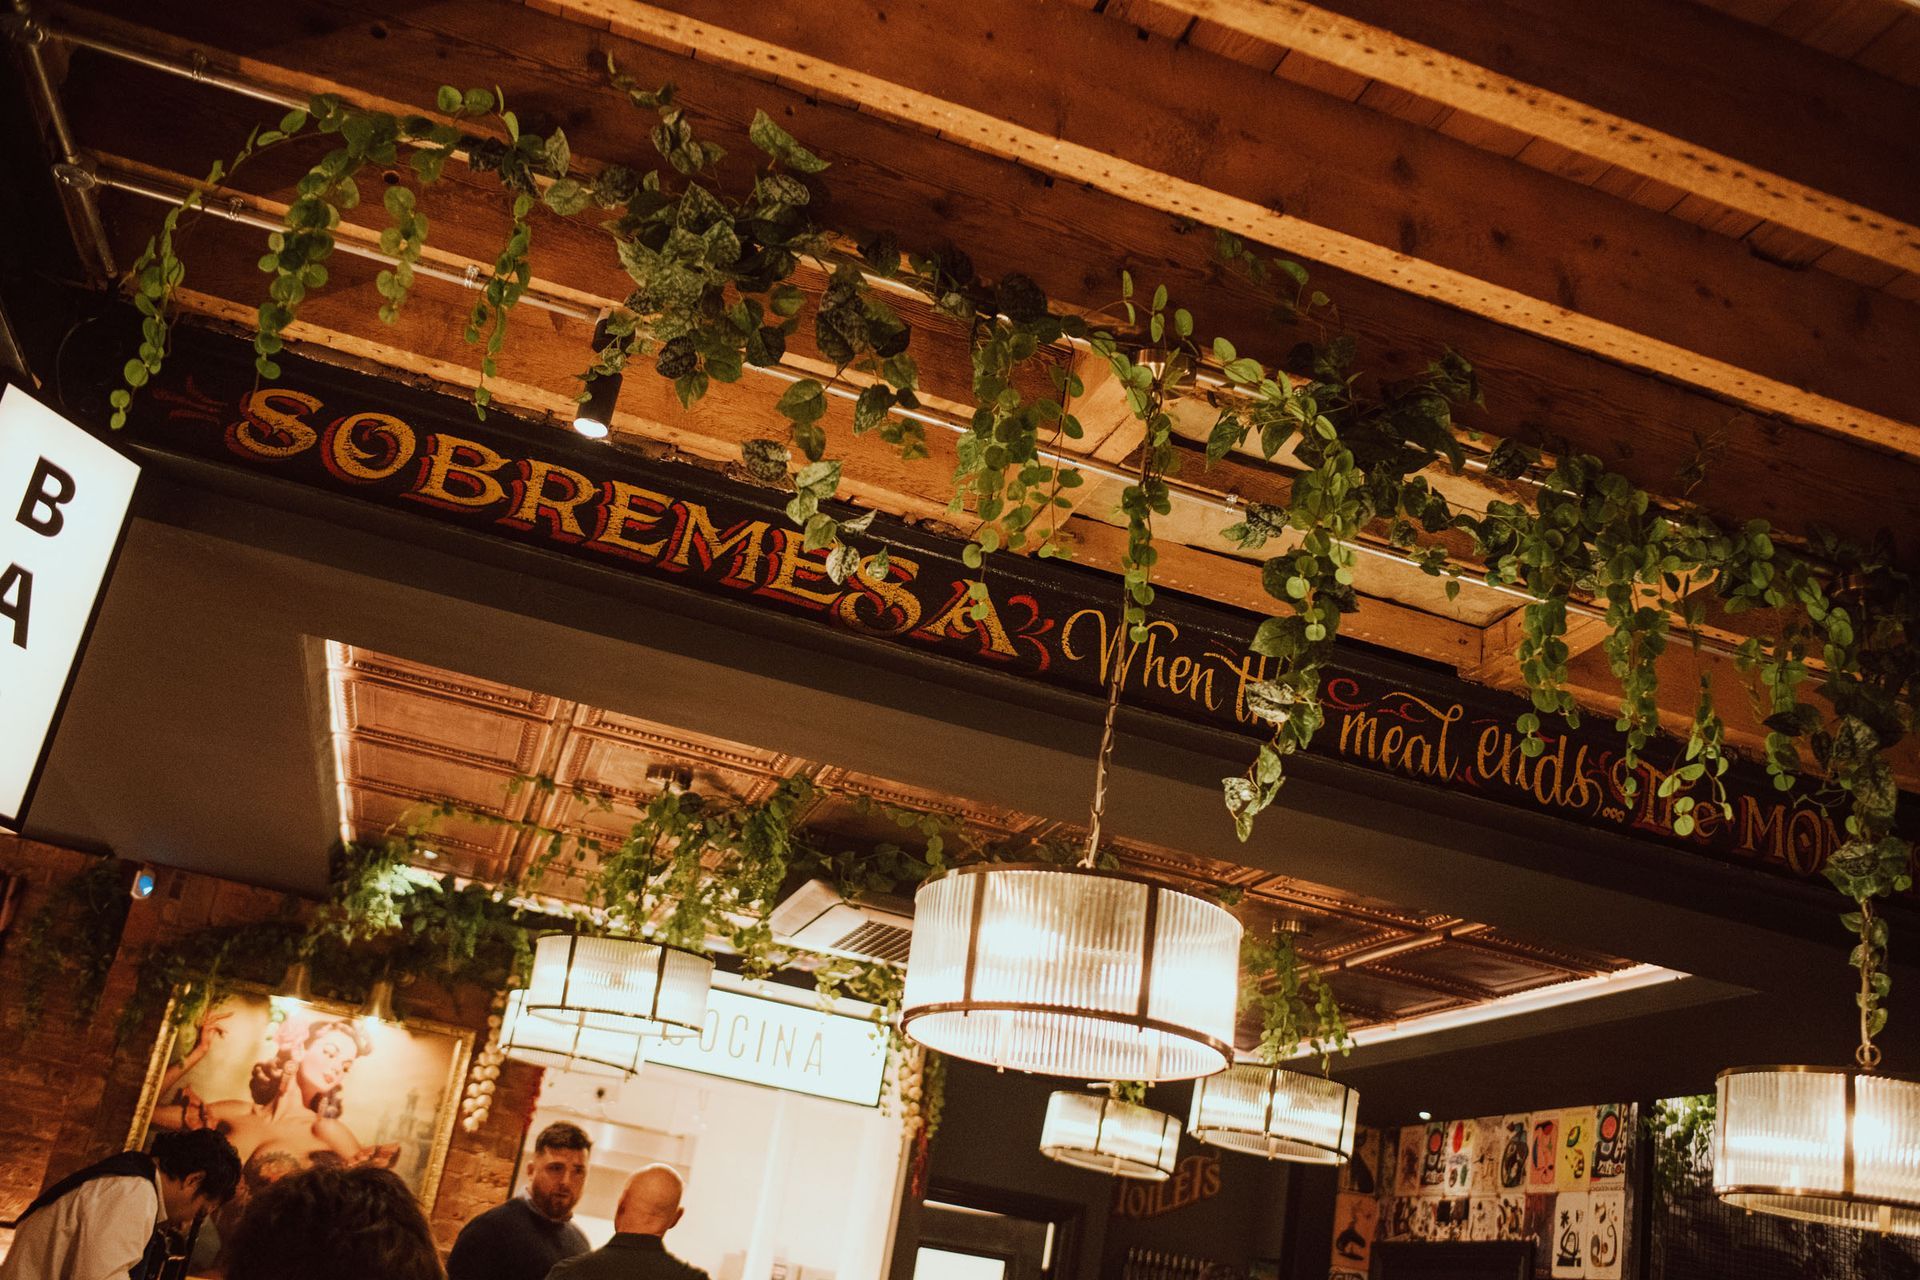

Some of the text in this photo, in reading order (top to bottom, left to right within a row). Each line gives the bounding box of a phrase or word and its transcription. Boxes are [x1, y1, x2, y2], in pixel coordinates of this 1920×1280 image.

[226, 388, 1020, 661] SOBREMESA
[1062, 609, 1223, 712] When
[1340, 692, 1464, 782] meal
[667, 1008, 824, 1076] OCINA
